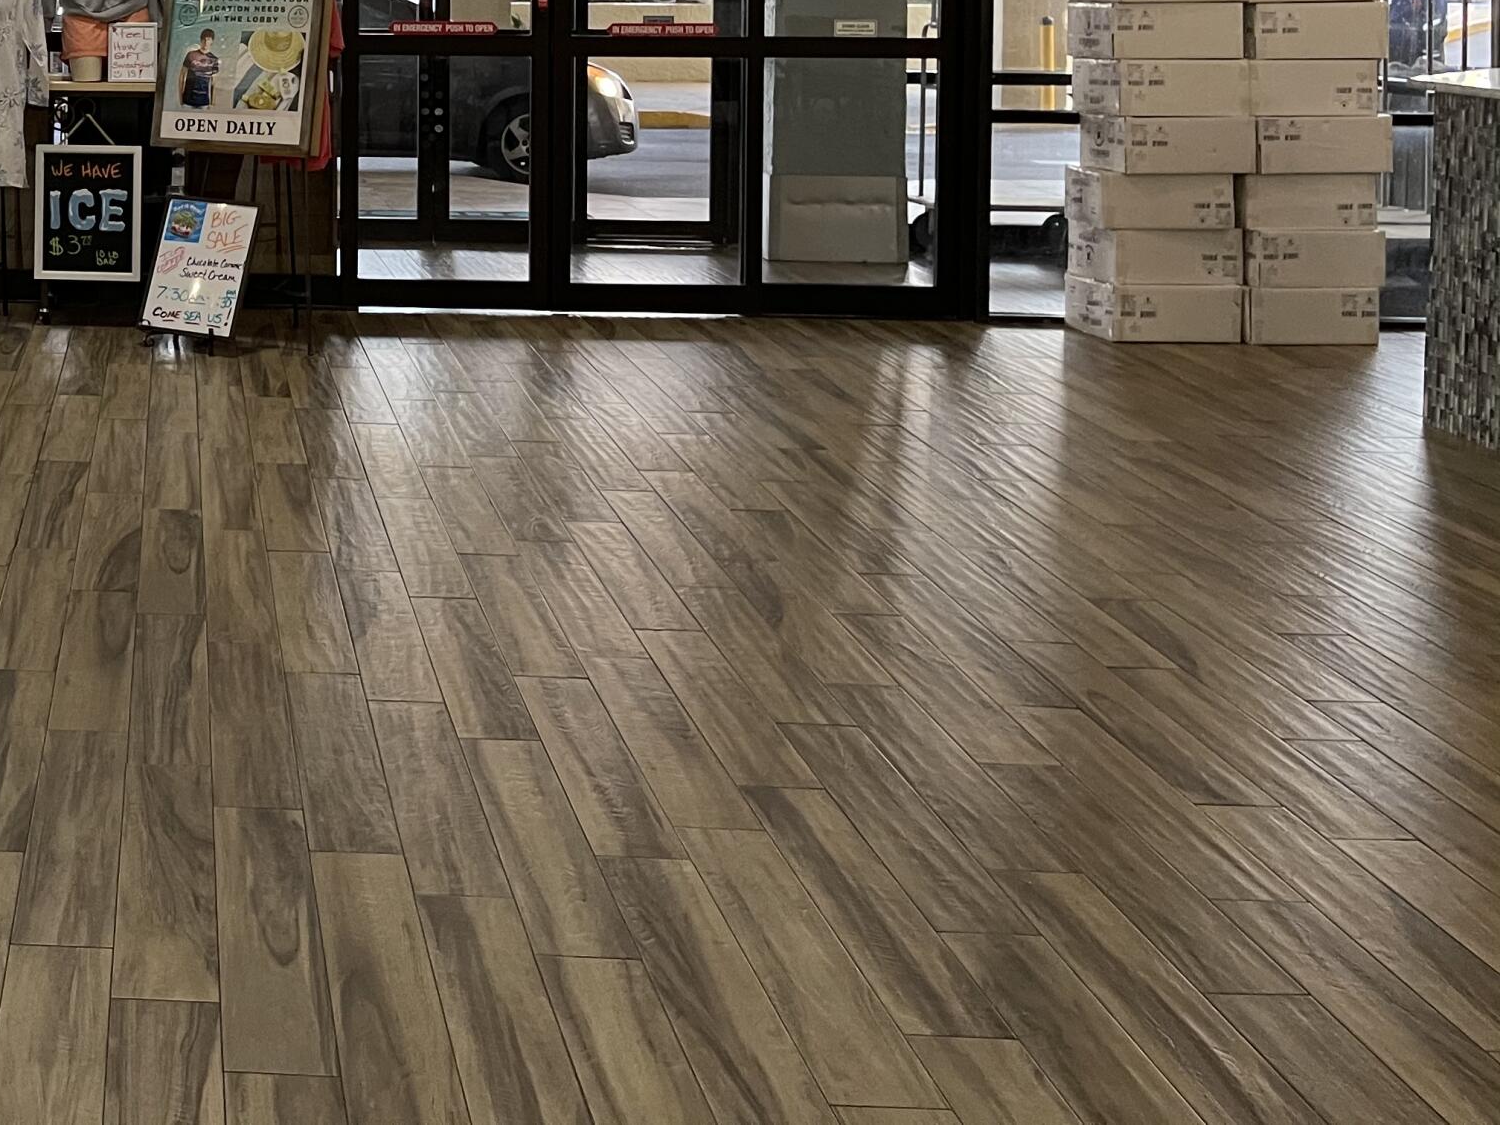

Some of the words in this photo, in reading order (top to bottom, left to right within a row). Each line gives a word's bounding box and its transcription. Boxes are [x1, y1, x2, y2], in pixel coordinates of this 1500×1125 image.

[254, 5, 286, 13] NEEDS
[224, 15, 243, 23] THE
[393, 24, 400, 32] IN
[402, 24, 442, 32] EMERGENCY
[445, 24, 463, 32] PUSH
[465, 24, 473, 32] TO
[474, 24, 493, 32] OPEN
[611, 25, 620, 34] IN
[621, 25, 662, 34] EMERGENCY
[665, 25, 683, 34] PUSH
[685, 25, 694, 34] TO
[695, 25, 713, 34] OPEN
[174, 118, 219, 133] OPEN
[226, 120, 277, 136] DAILY
[51, 159, 74, 177] WE
[81, 160, 122, 179] HAVE
[49, 188, 128, 232] ICE
[211, 210, 241, 228] BIG
[205, 224, 248, 250] SALE
[207, 270, 237, 282] Cream
[152, 306, 181, 319] COME
[183, 310, 202, 322] SEA
